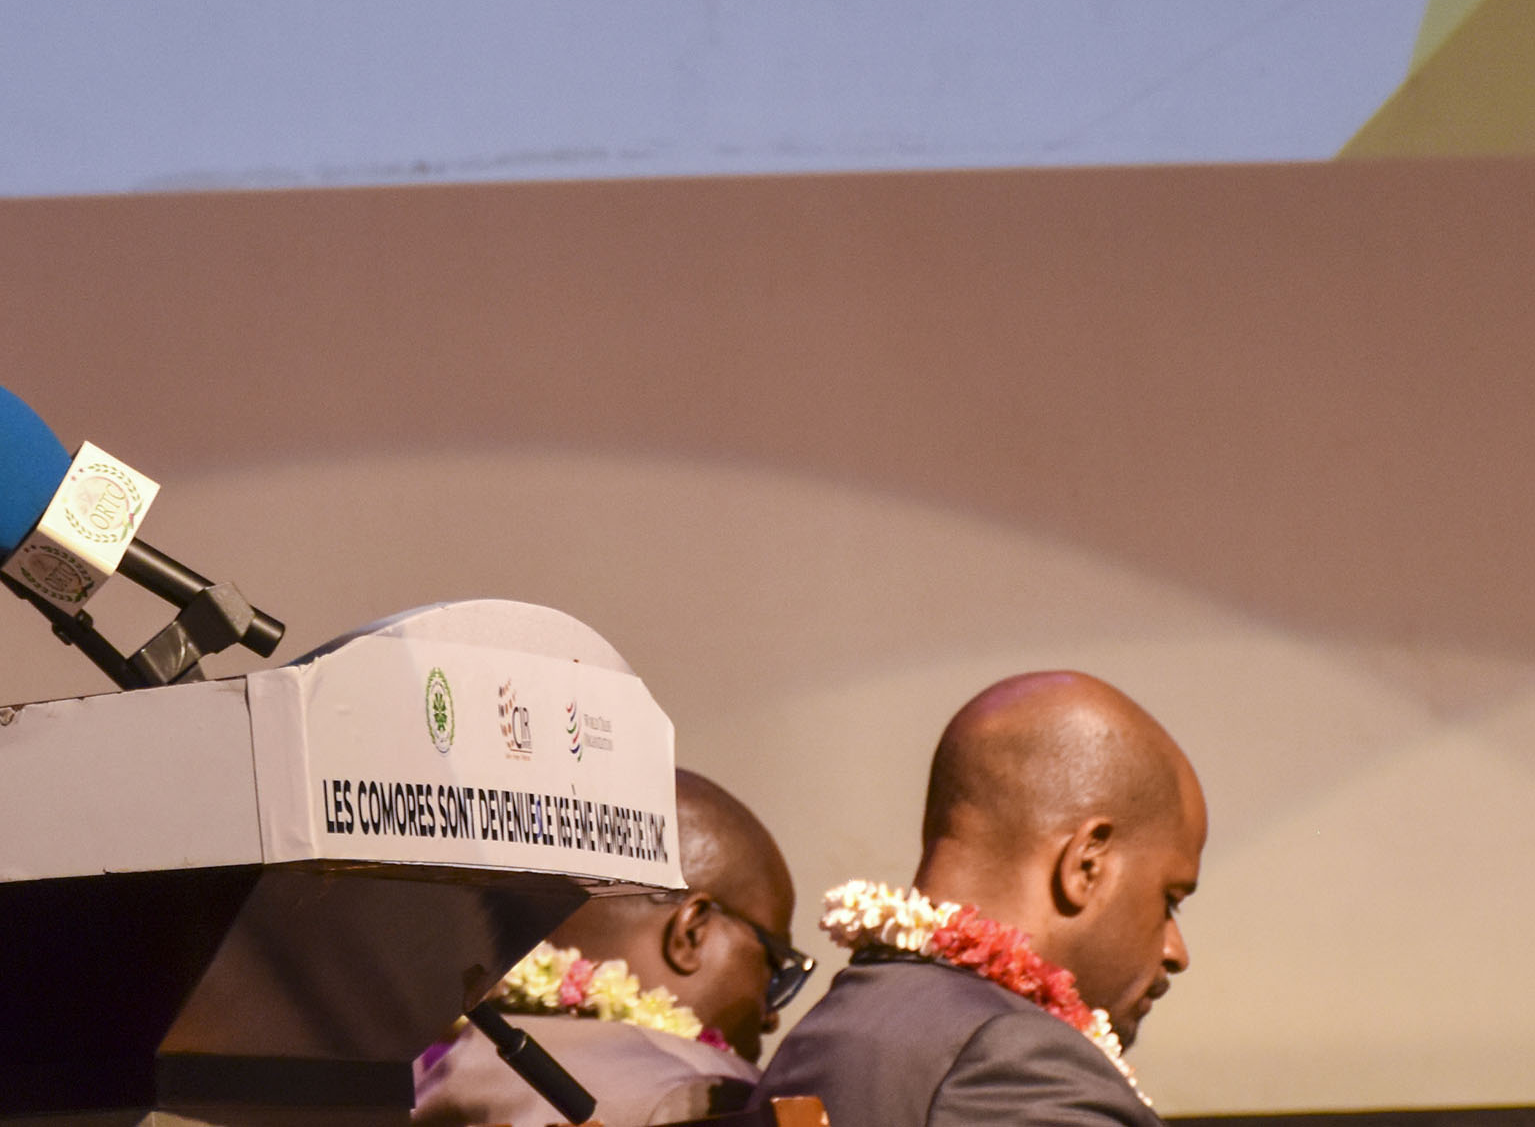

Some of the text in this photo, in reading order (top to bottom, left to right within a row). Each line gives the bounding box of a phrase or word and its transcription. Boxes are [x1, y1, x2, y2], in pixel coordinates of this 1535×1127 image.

[323, 779, 354, 834] LES
[357, 780, 436, 837] COMORES
[438, 784, 475, 840] SONT
